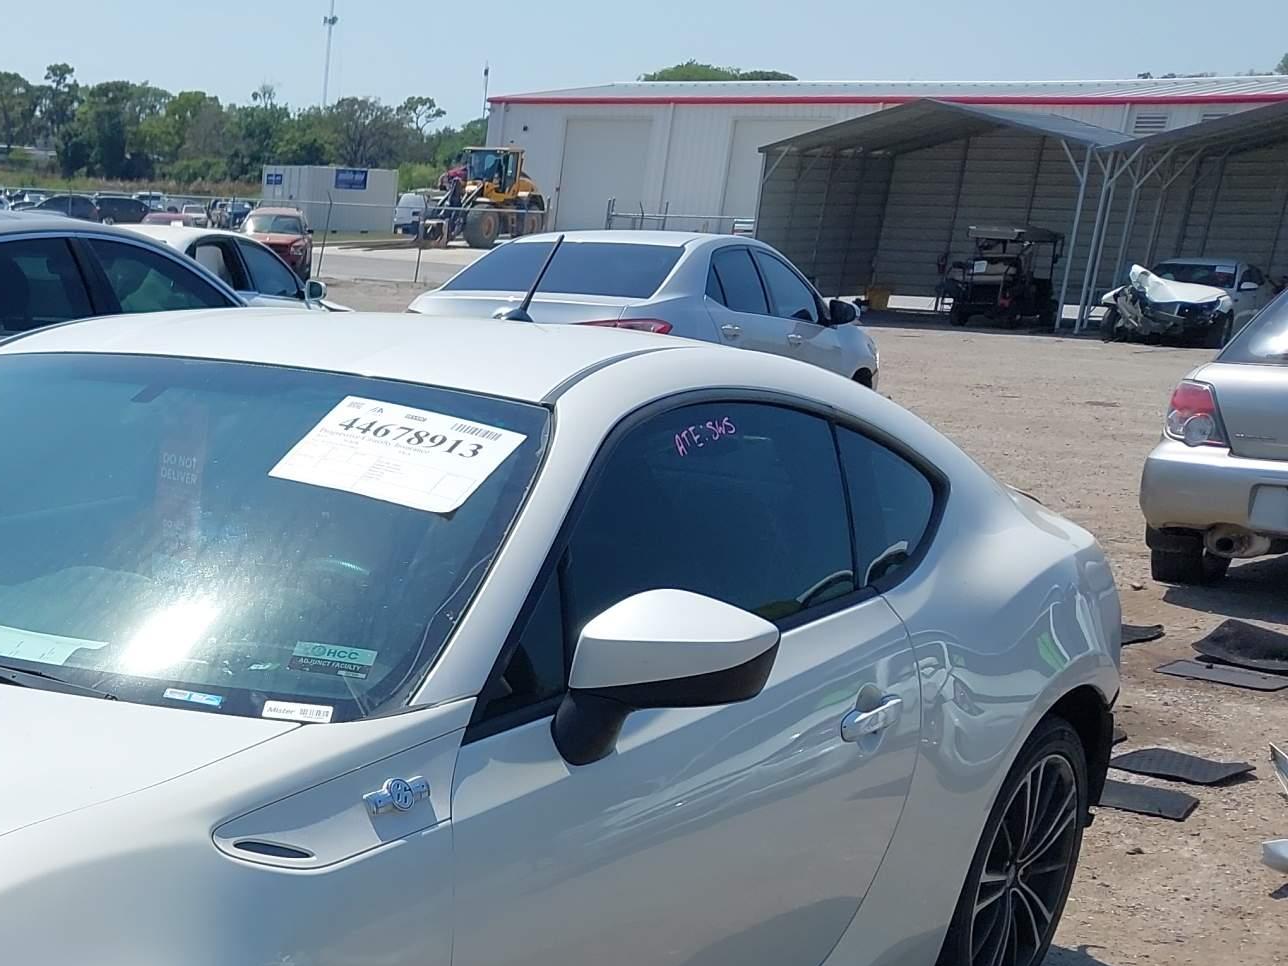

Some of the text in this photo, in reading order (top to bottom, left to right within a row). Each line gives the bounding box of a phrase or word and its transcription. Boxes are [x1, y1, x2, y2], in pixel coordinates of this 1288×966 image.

[338, 417, 484, 459] 44678913
[161, 466, 197, 485] DELIVER
[326, 648, 360, 660] HCC
[298, 657, 362, 671] ADJUNCT FACULTY
